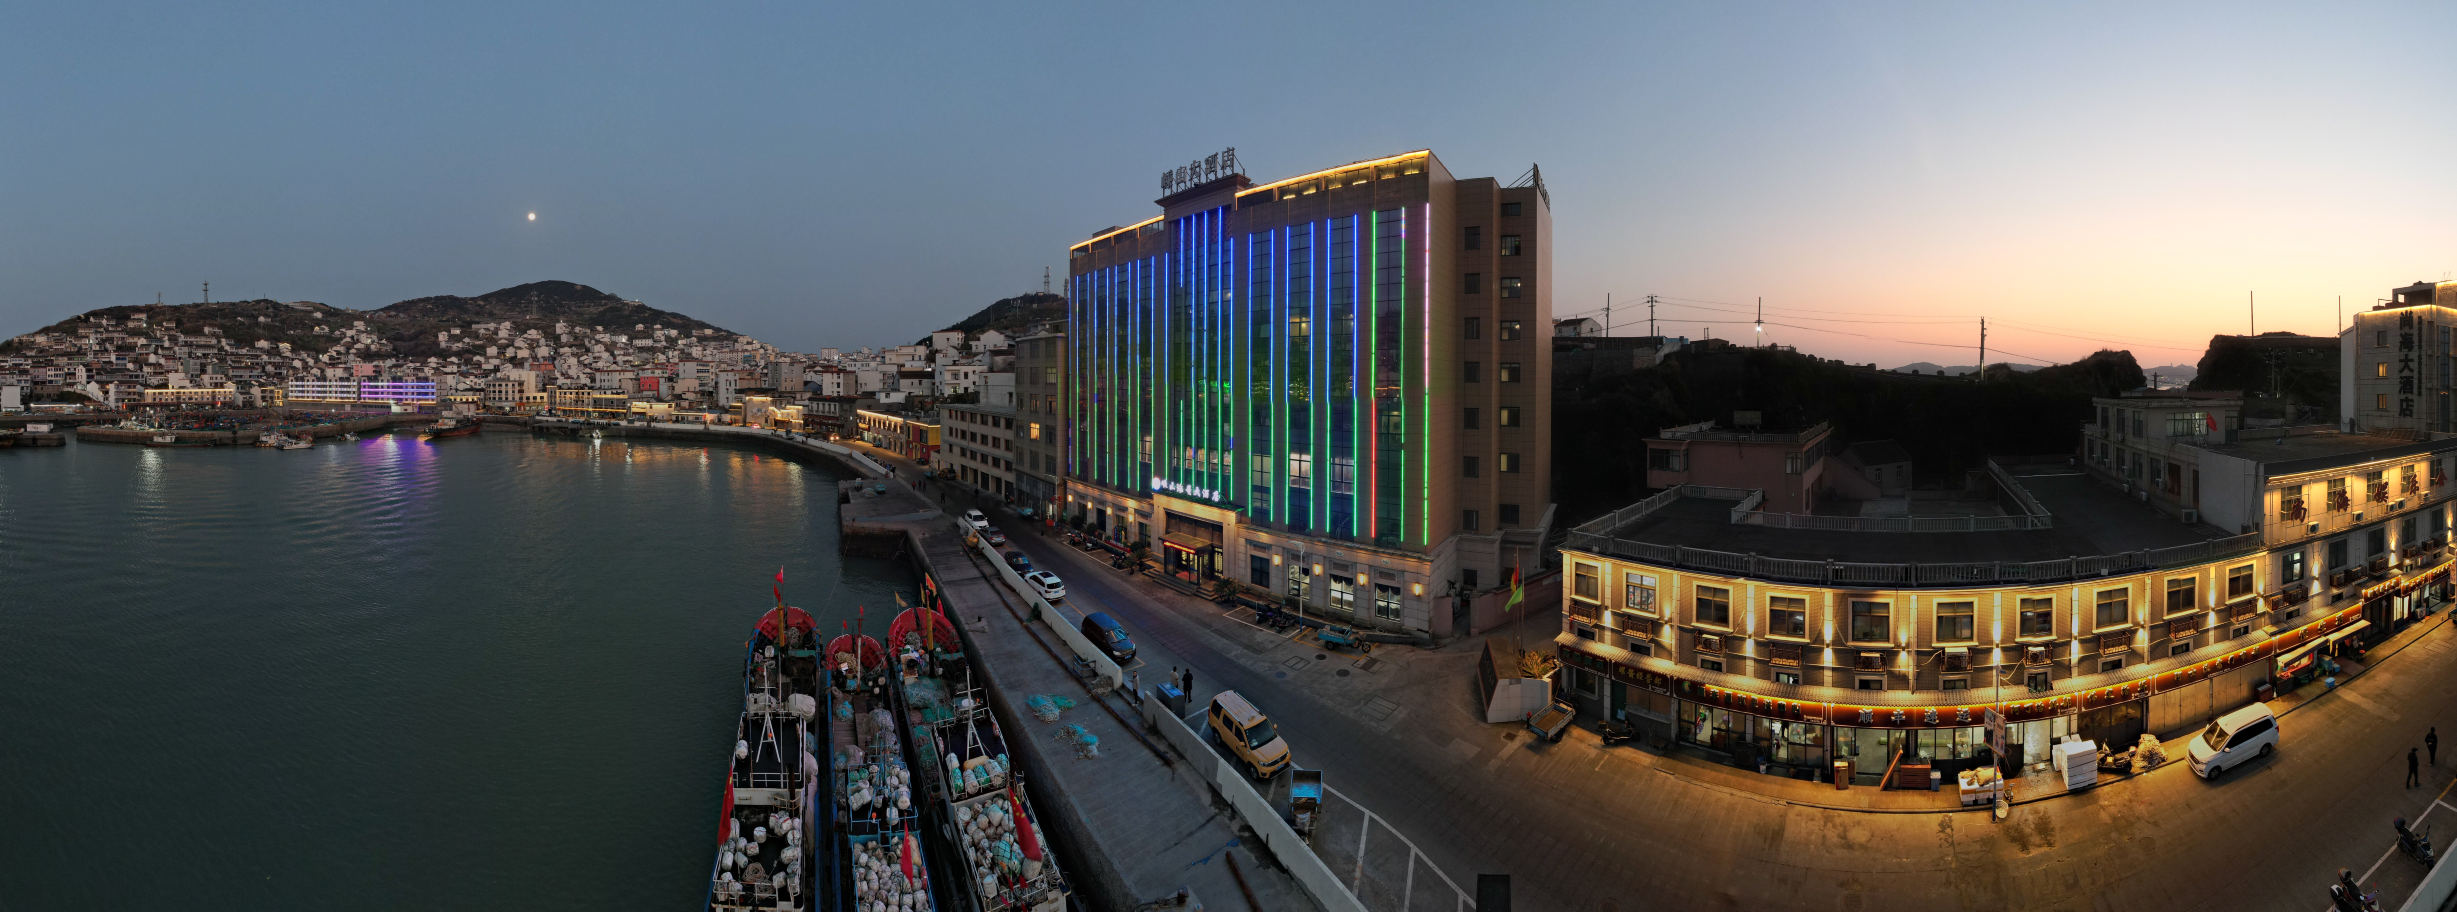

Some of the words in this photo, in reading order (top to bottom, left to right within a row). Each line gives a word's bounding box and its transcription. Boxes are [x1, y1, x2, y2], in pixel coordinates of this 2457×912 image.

[2399, 310, 2414, 418] 尚海大酒店
[1858, 706, 1972, 725] 顺丰速运
